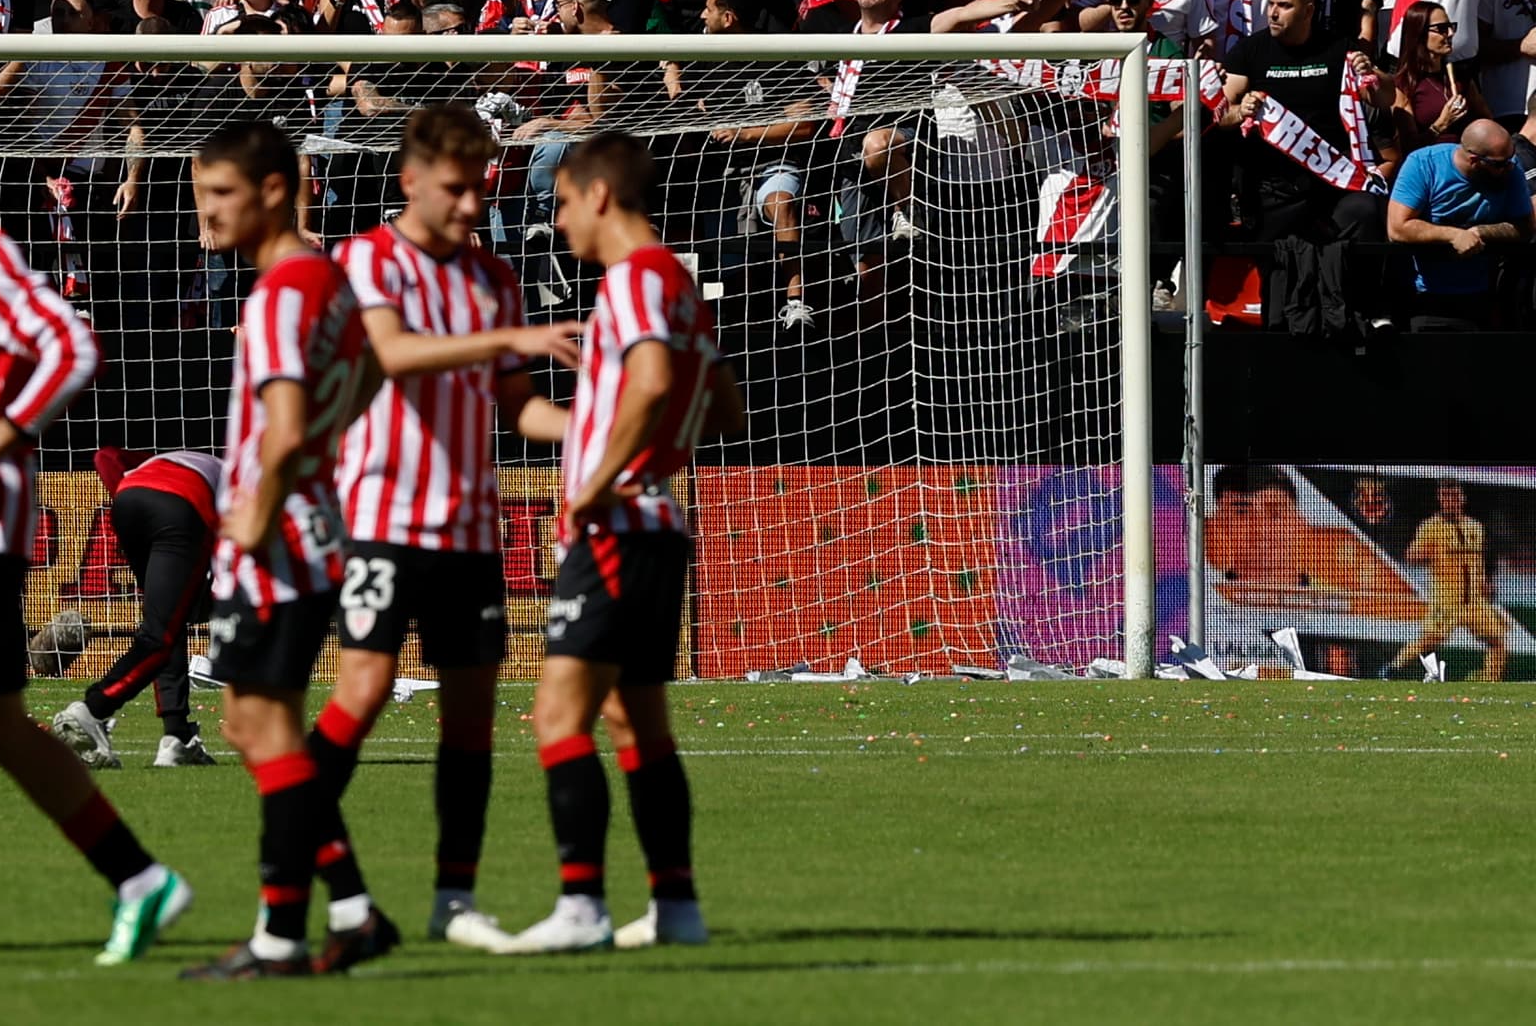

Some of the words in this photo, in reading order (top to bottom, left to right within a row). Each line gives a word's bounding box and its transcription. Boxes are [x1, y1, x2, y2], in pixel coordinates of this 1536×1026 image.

[1099, 58, 1186, 96] VTE
[1262, 95, 1358, 190] PRESA
[338, 556, 397, 612] 23
